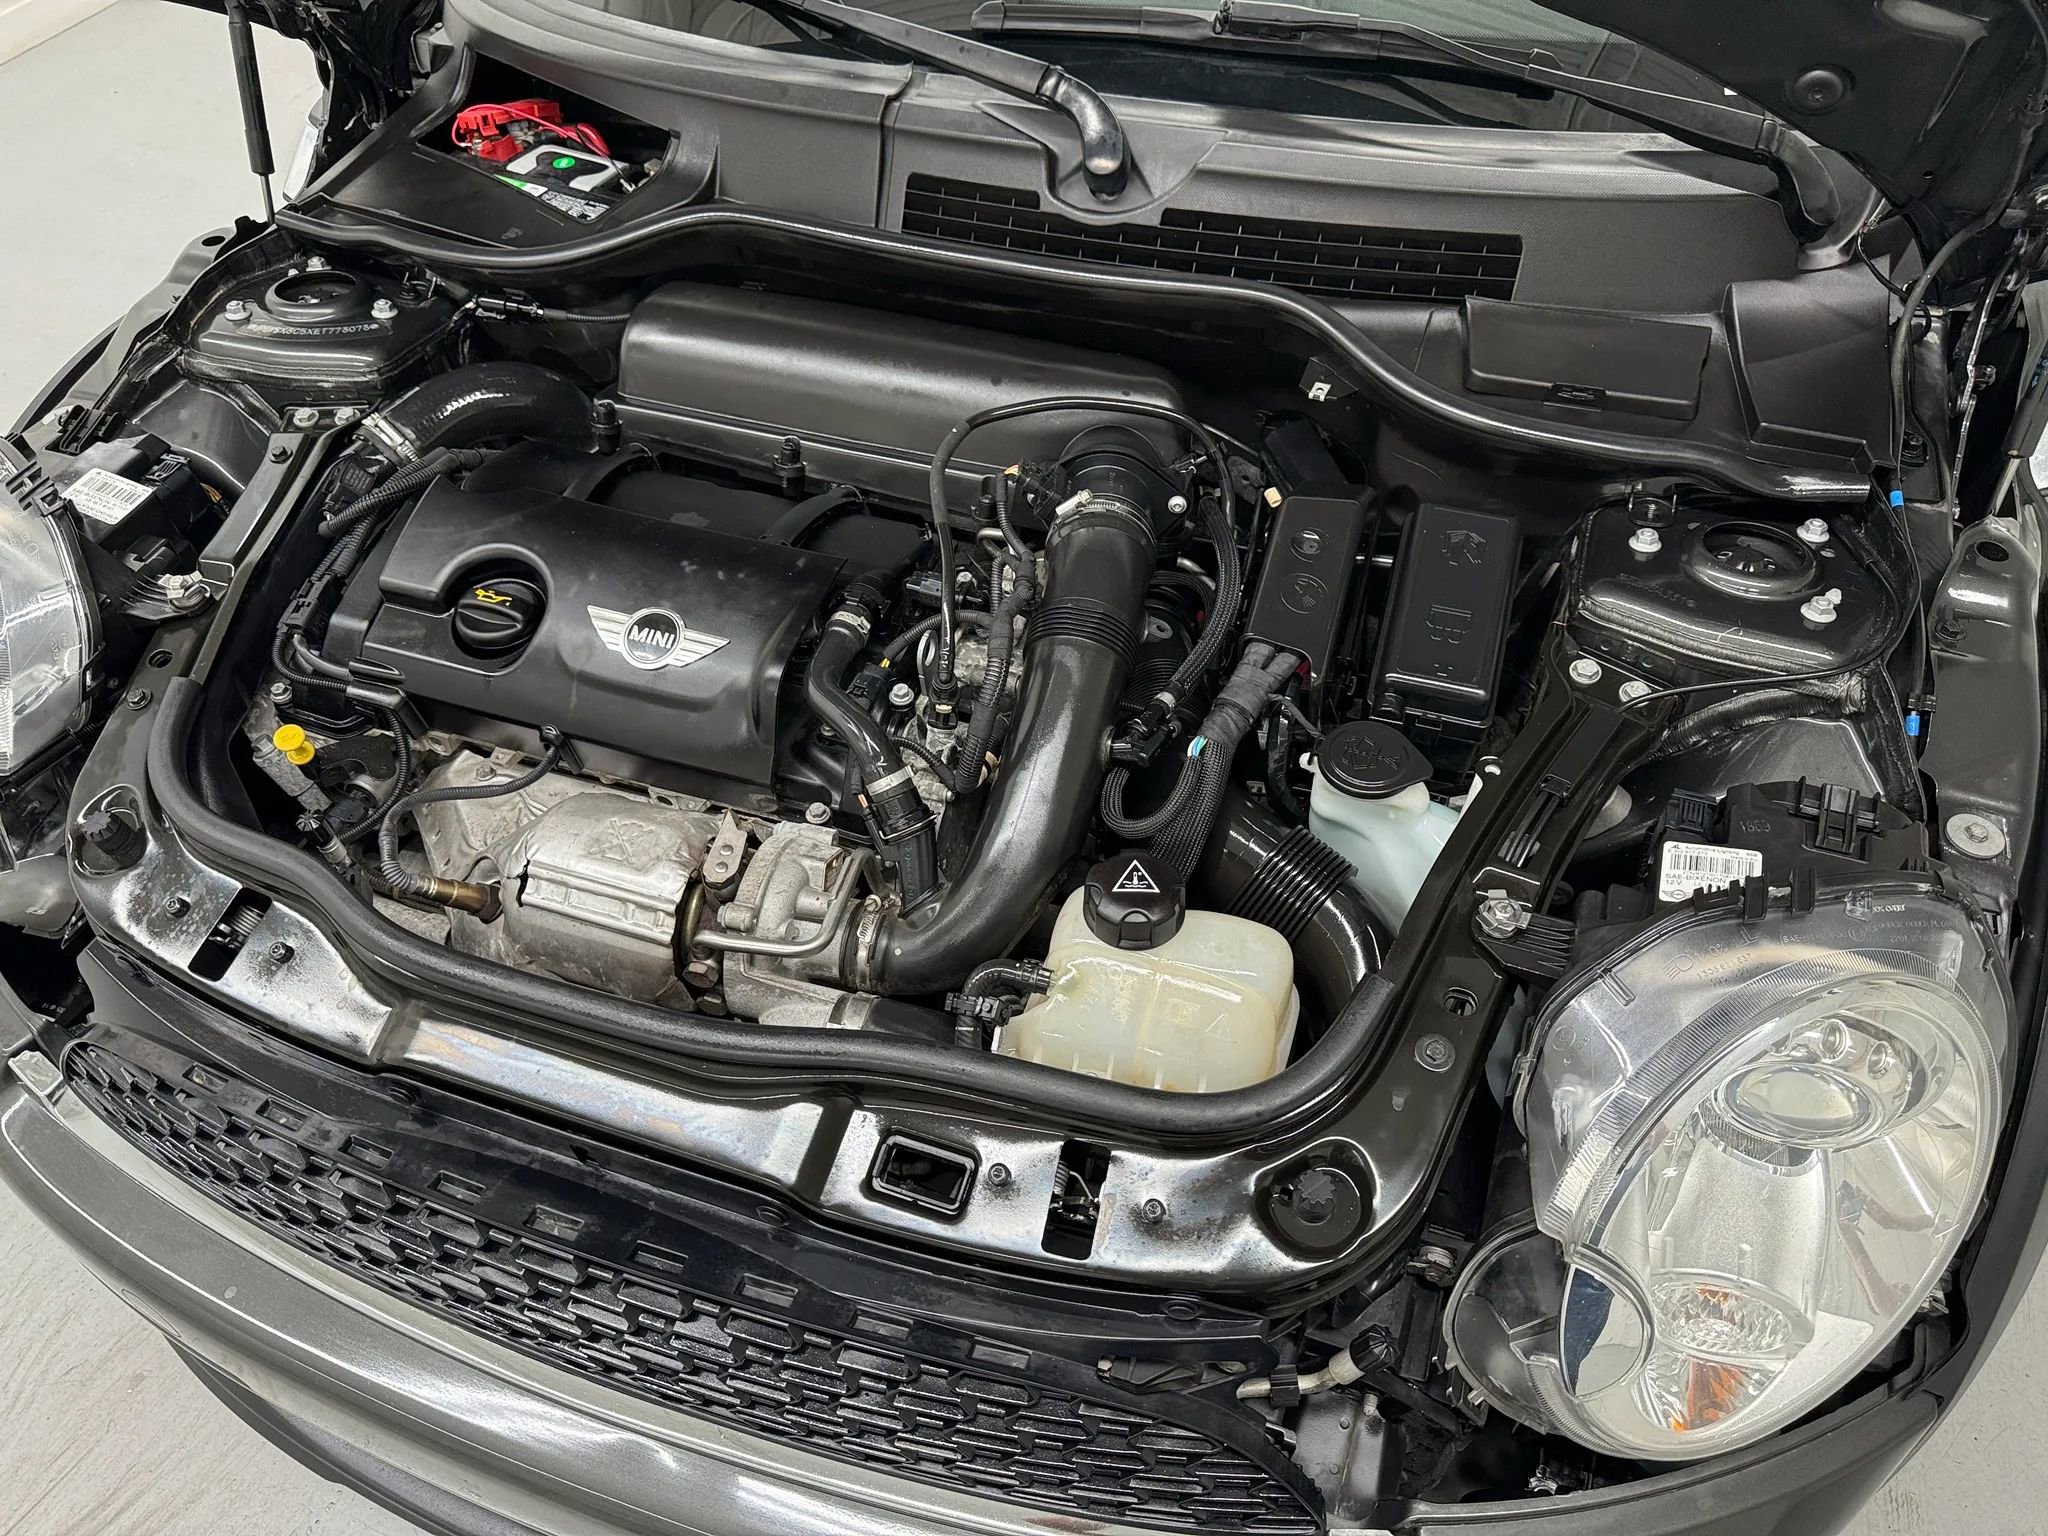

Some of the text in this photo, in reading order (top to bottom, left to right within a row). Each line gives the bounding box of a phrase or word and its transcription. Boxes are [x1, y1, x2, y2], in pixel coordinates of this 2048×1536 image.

[628, 624, 675, 649] MINI
[1685, 845, 1716, 853] Automotive
[1665, 873, 1727, 884] SAE-BIXENON
